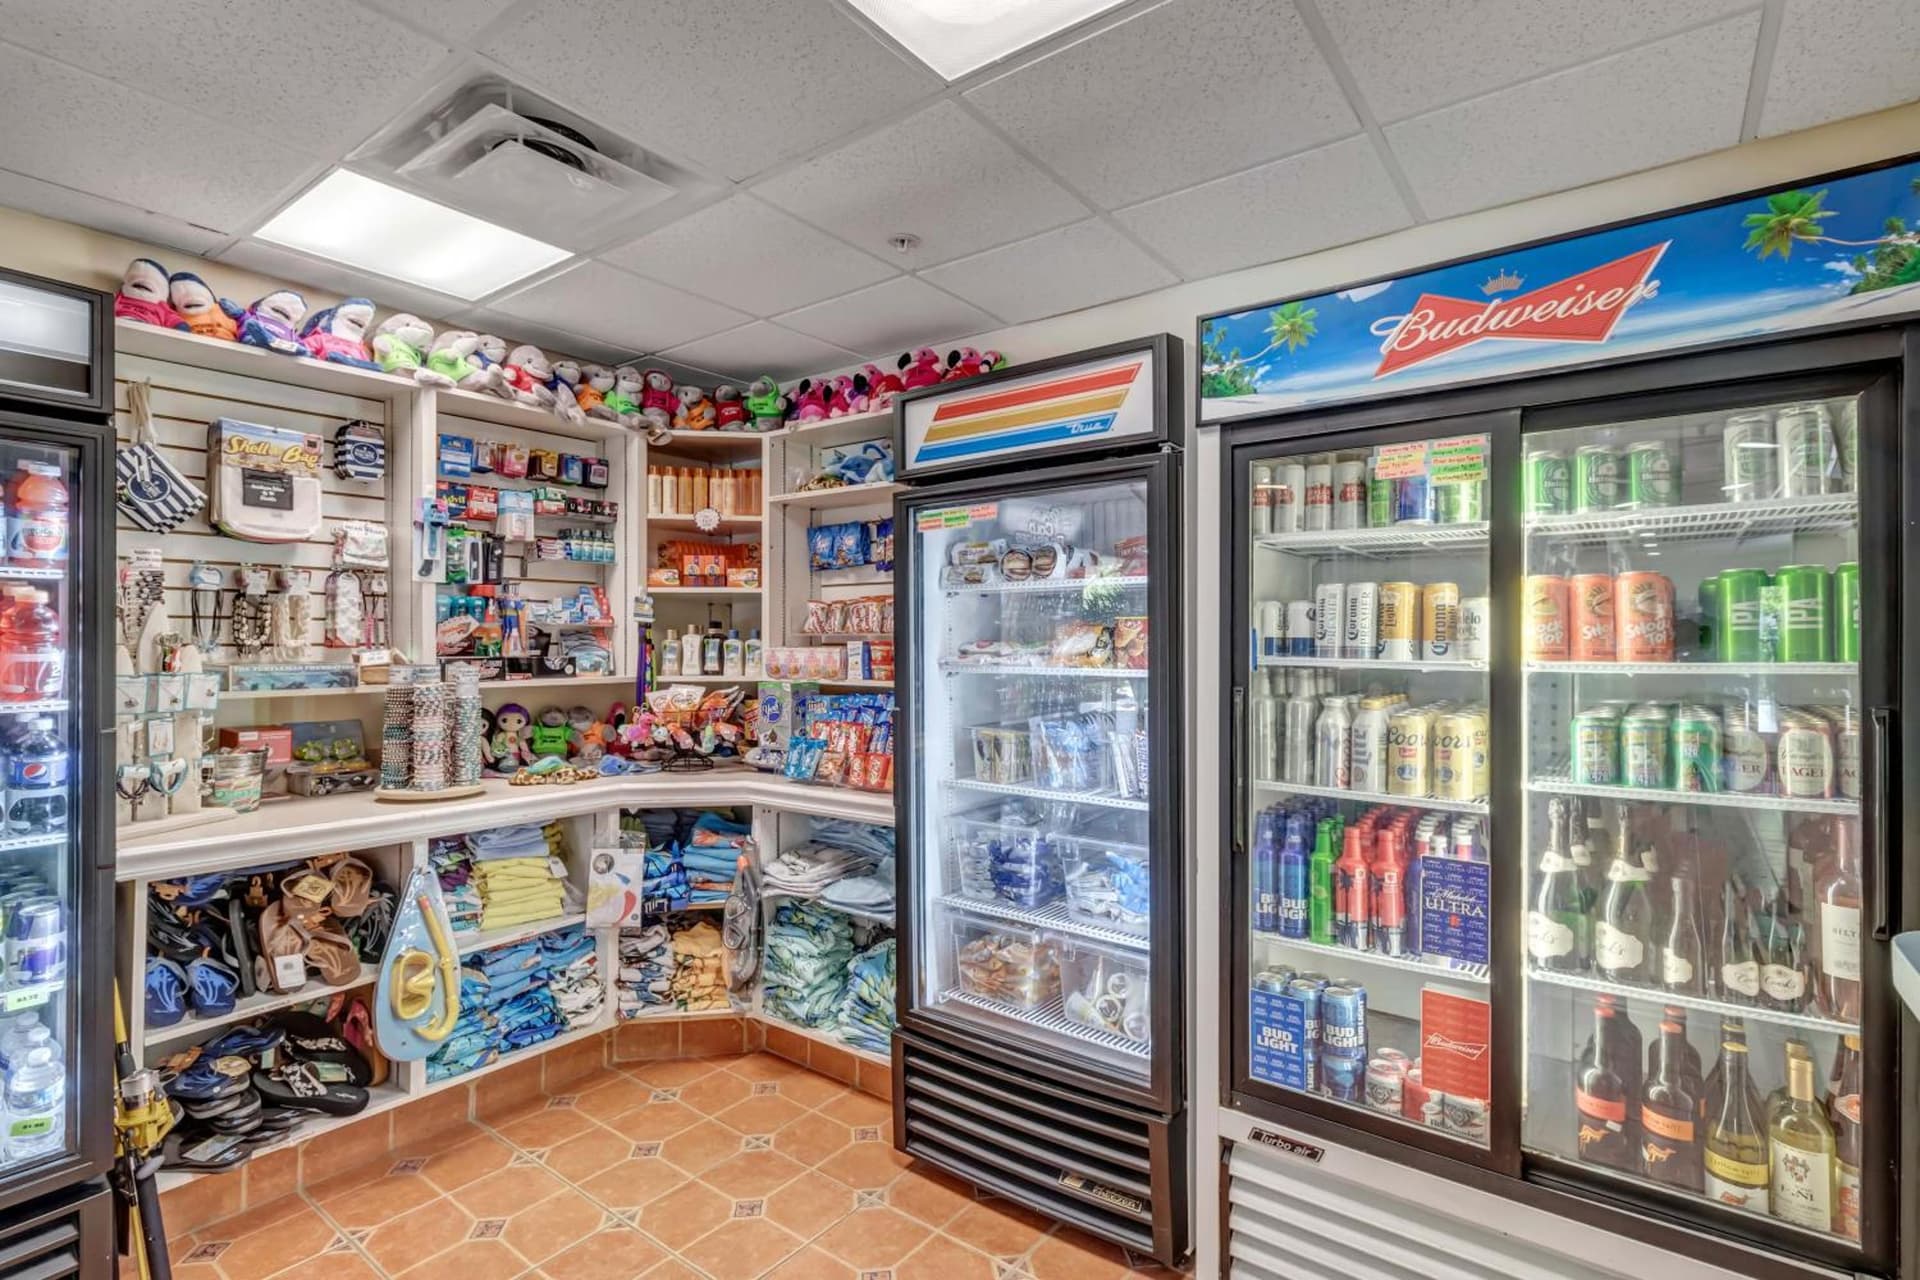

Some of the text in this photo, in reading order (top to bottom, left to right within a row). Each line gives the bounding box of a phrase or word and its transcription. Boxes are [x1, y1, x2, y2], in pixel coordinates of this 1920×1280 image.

[1370, 278, 1662, 354] Budweiser
[1066, 421, 1106, 435] True
[224, 436, 270, 455] Shell
[1316, 598, 1328, 640] Corona
[1347, 598, 1359, 640] Corona
[1786, 598, 1823, 629] IPA
[1430, 604, 1450, 656] Corona
[1279, 905, 1307, 920] LIGH
[1425, 896, 1487, 918] ULTRA
[1262, 1025, 1293, 1042] BUD
[1323, 1032, 1358, 1048] LIGHT
[1326, 1024, 1355, 1037] BUD
[1256, 1034, 1299, 1054] LIGHT
[1260, 1131, 1312, 1157] Turbo air
